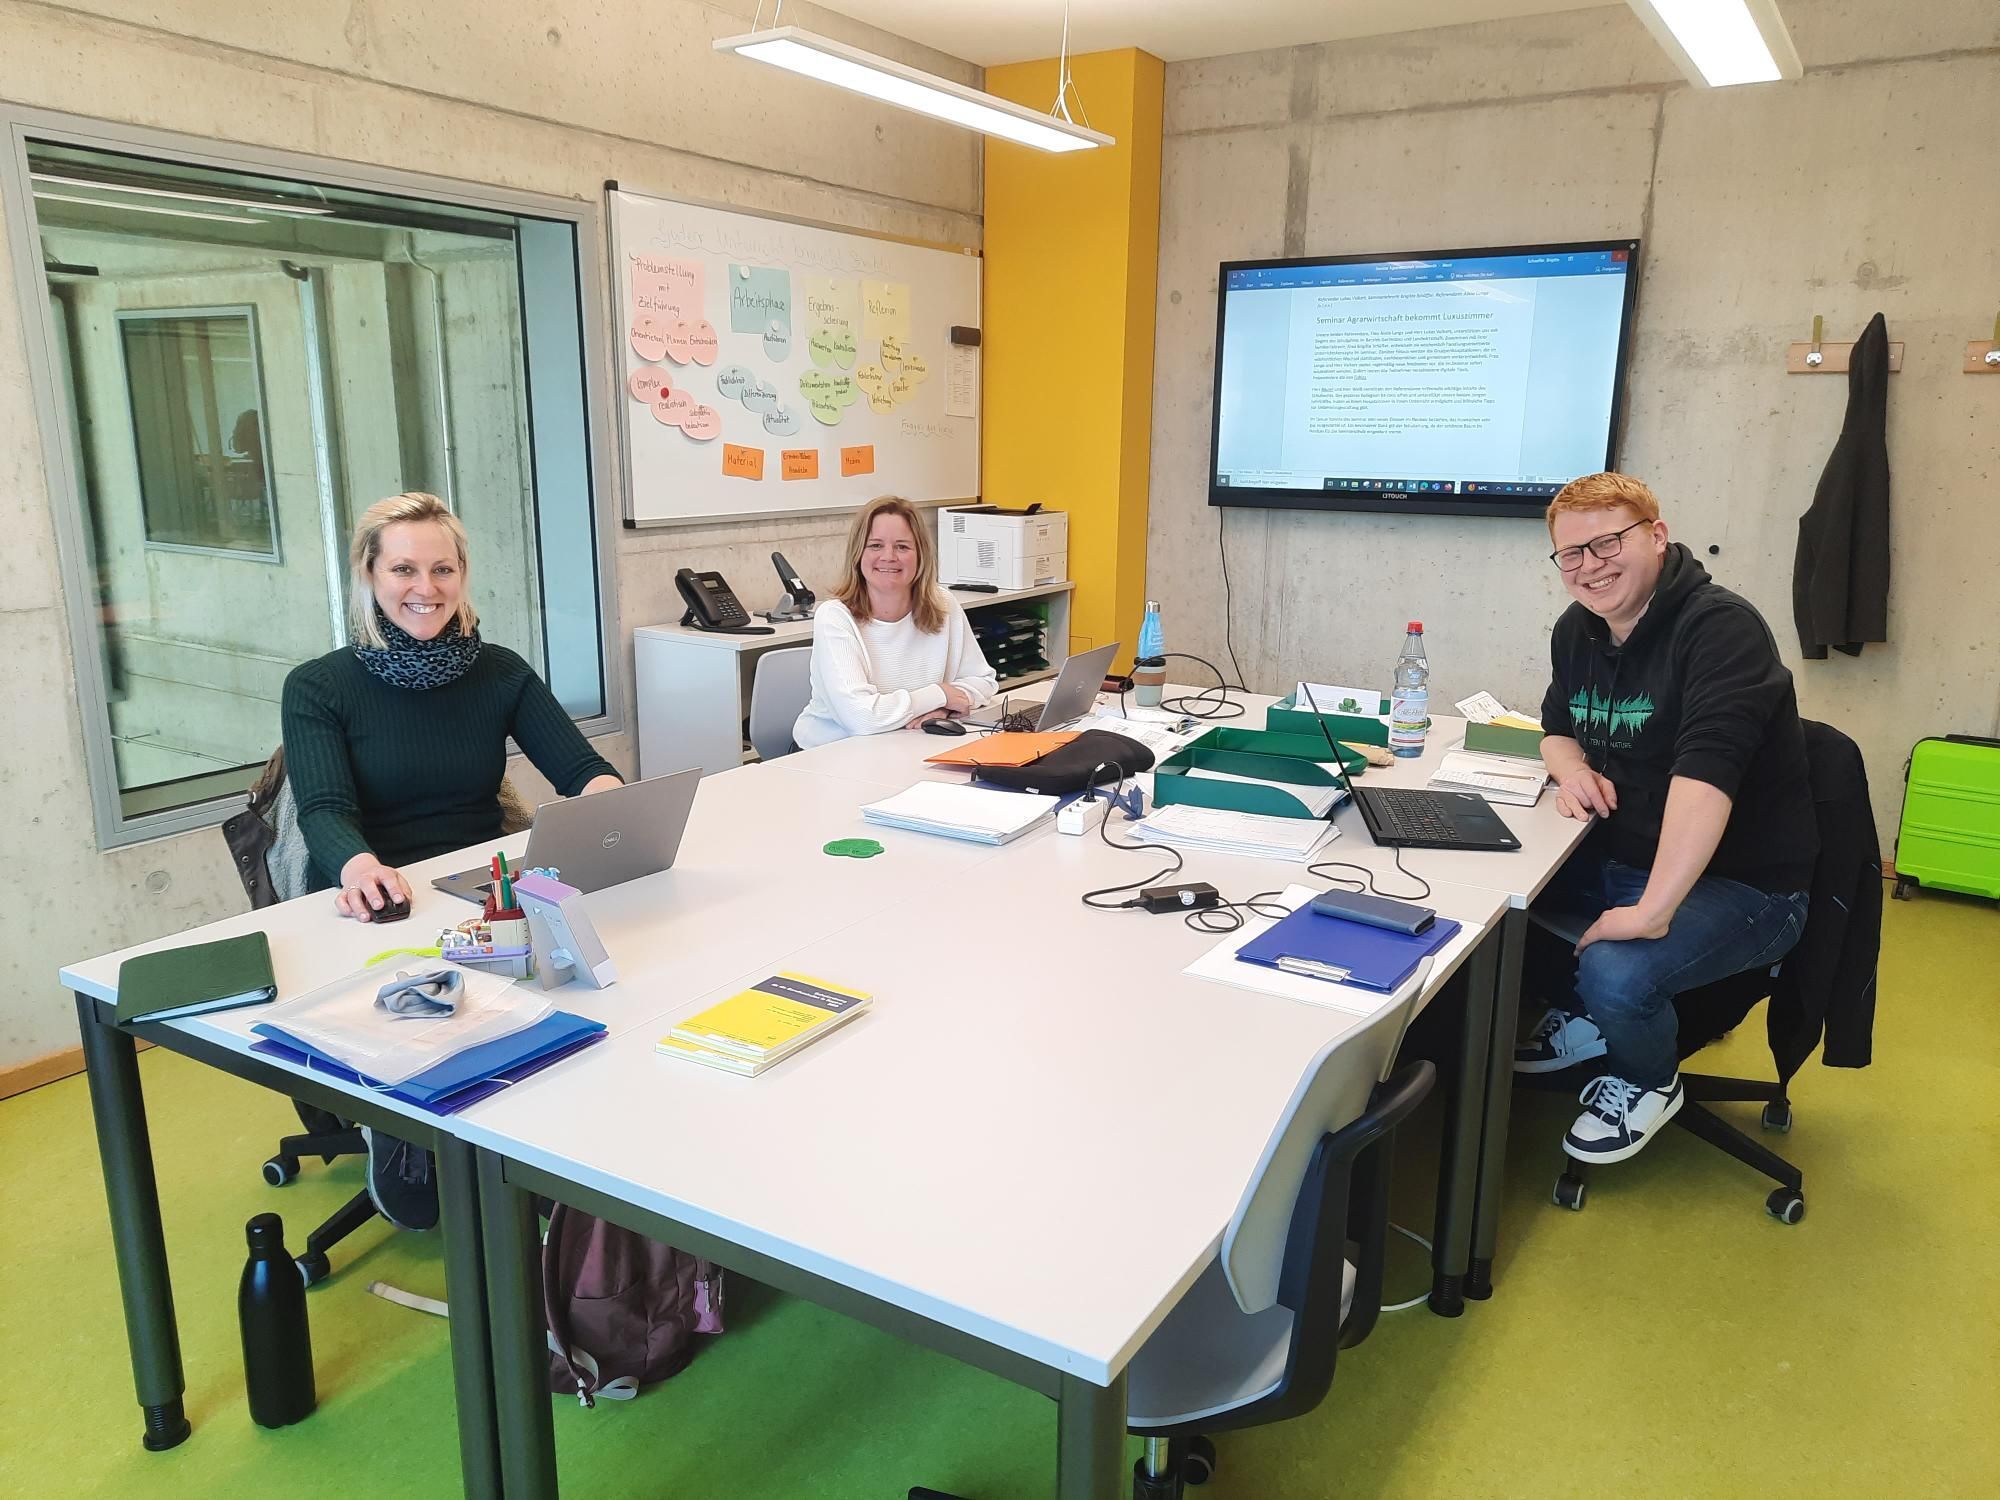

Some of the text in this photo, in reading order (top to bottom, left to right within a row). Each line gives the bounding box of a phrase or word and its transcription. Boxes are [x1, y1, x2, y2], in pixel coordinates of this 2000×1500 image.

[635, 258, 695, 287] Problemstellung
[658, 283, 671, 292] mit
[638, 296, 680, 318] Zielführung
[733, 286, 785, 318] Arbeitsphase
[1316, 312, 1494, 325] Seminar Agrarwirtschaft bekommt Luxuszimmer
[727, 454, 757, 469] Material
[1610, 741, 1633, 749] NATURE
